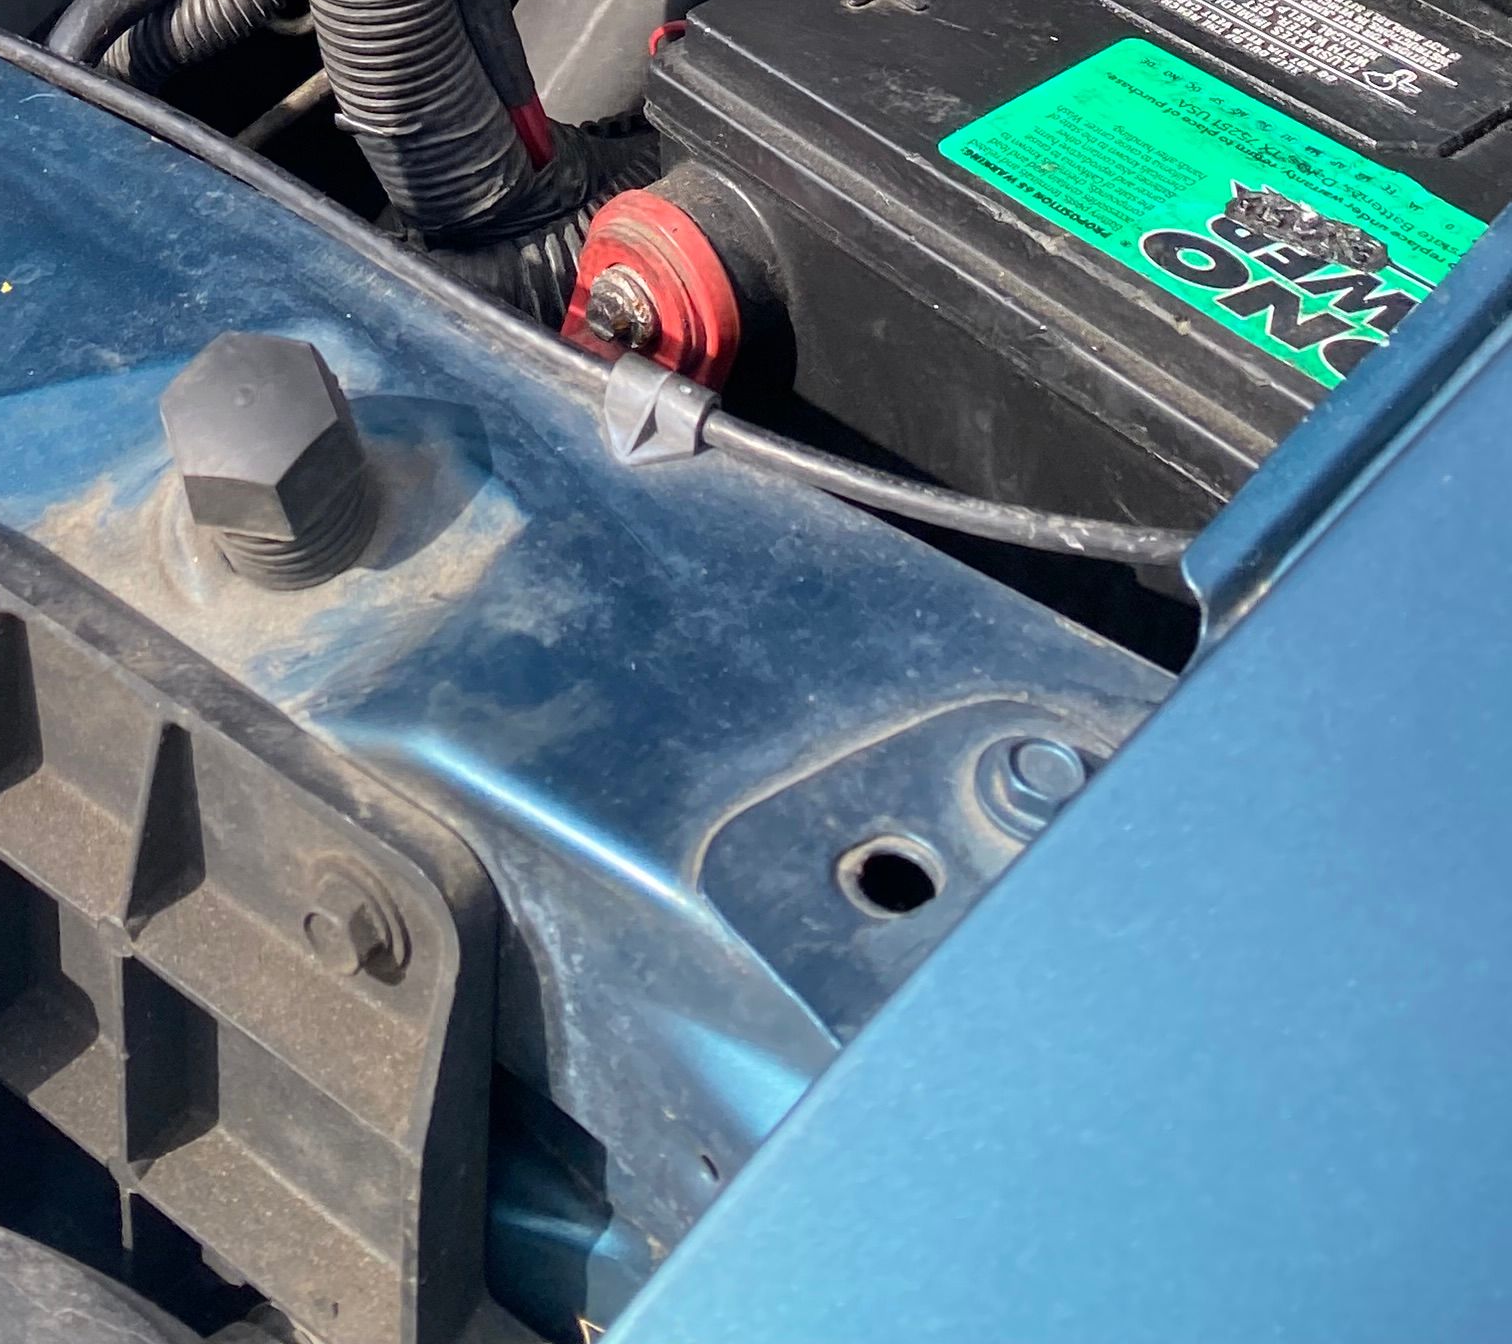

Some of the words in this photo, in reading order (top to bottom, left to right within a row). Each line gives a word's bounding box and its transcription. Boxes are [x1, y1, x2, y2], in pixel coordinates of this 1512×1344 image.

[1200, 10, 1233, 29] VENT
[1241, 0, 1274, 17] GET
[1276, 6, 1316, 27] HELP
[1270, 26, 1310, 49] EYES
[1318, 24, 1382, 60] MEDICAL
[1307, 46, 1359, 74] FLUSH
[1327, 43, 1369, 67] WITH
[1056, 105, 1083, 123] Wash
[1162, 107, 1181, 117] of
[1178, 99, 1211, 121] USA
[1181, 116, 1220, 137] place
[1211, 119, 1259, 146] 75251
[1010, 138, 1043, 160] known
[1218, 136, 1234, 146] to
[1258, 143, 1282, 160] TX
[998, 157, 1021, 171] and
[1006, 150, 1030, 163] and
[1081, 143, 1116, 165] contain
[1107, 147, 1140, 169] known
[962, 147, 1018, 184] WARNING:
[1060, 156, 1104, 184] California
[1151, 159, 1196, 186] California
[1016, 182, 1035, 193] 65
[1047, 173, 1083, 196] contain
[1111, 175, 1136, 188] and
[1033, 192, 1112, 238] PROPOSITION
[1344, 203, 1389, 231] under
[1390, 231, 1446, 263] replace
